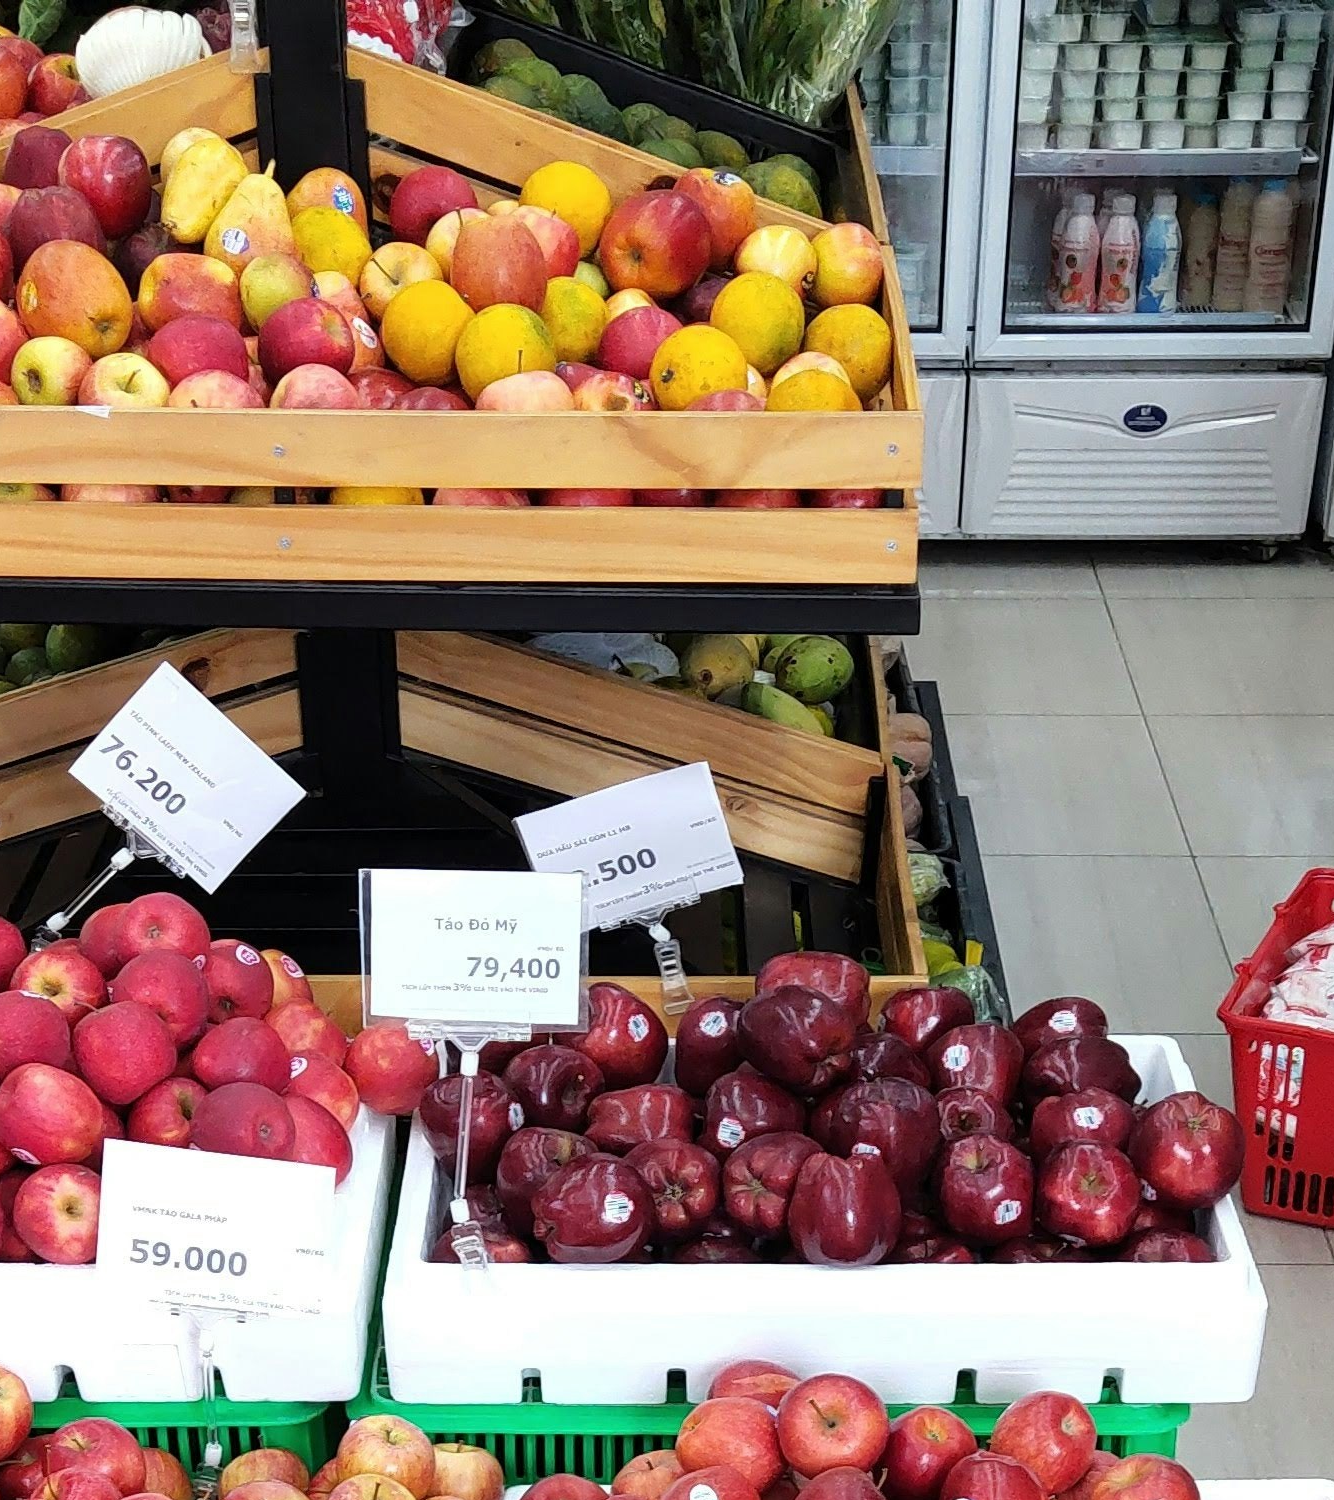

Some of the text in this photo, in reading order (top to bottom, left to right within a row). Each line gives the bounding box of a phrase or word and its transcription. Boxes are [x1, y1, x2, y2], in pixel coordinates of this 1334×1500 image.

[98, 734, 187, 815] 76.200
[141, 815, 160, 834] 3%
[433, 916, 464, 931] Táo
[495, 917, 518, 934] Mỹ
[466, 956, 561, 983] 79,400
[452, 981, 472, 992] 3%
[129, 1238, 247, 1277] 59.000
